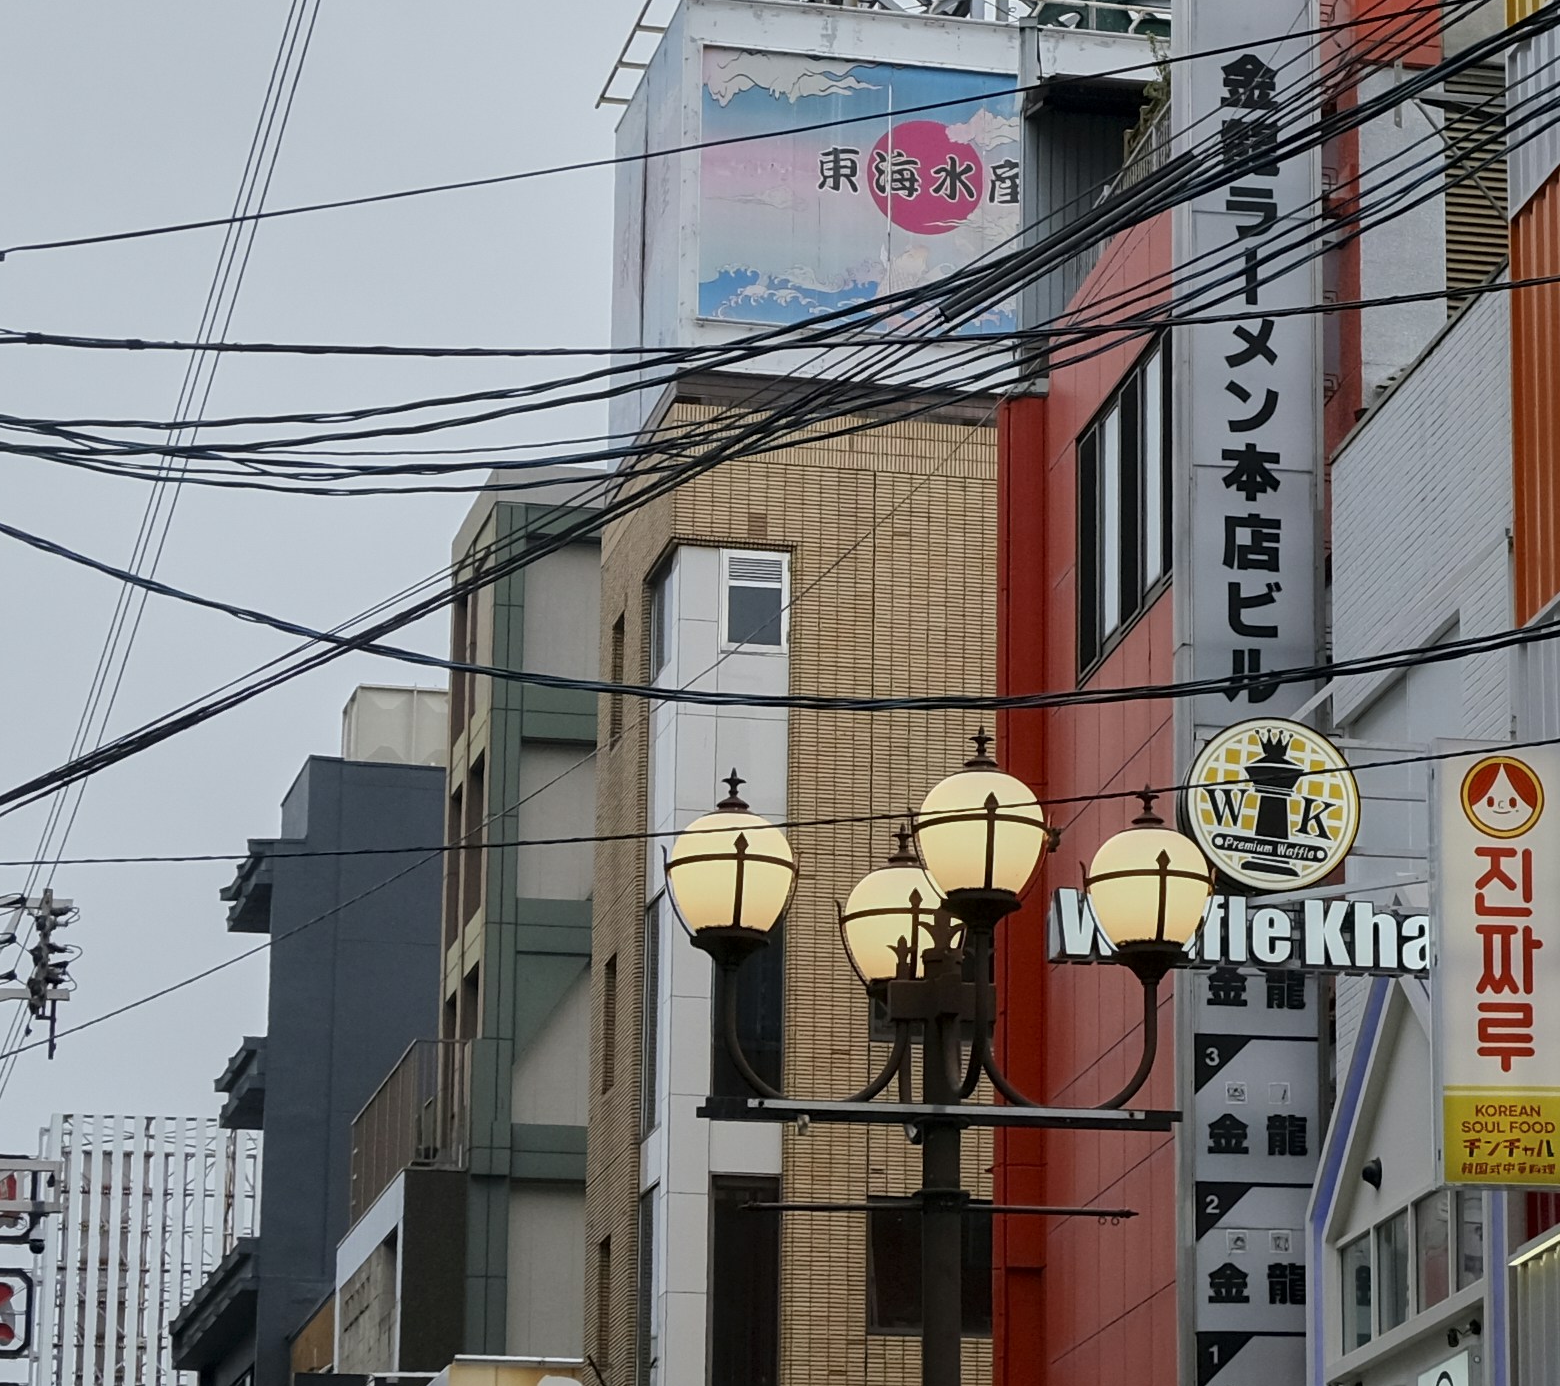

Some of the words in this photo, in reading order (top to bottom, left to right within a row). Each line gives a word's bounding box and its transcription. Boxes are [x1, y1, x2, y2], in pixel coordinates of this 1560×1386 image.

[1219, 54, 1282, 706] 金龍ラーメン本店ビル
[1203, 788, 1248, 827] W
[1295, 796, 1339, 841] K
[1224, 837, 1272, 854] Premium
[1277, 841, 1315, 860] Waffle
[1055, 887, 1292, 965] Wfle
[1474, 847, 1543, 1073] 진짜루
[1205, 1047, 1220, 1066] 3
[1475, 1104, 1541, 1117] KOREAN
[1208, 1113, 1308, 1156] 金龍
[1461, 1121, 1506, 1135] SOUL
[1510, 1121, 1556, 1135] FOOD
[1205, 1196, 1220, 1213] 2
[1208, 1262, 1306, 1304] 金龍
[1208, 1345, 1220, 1364] 1
